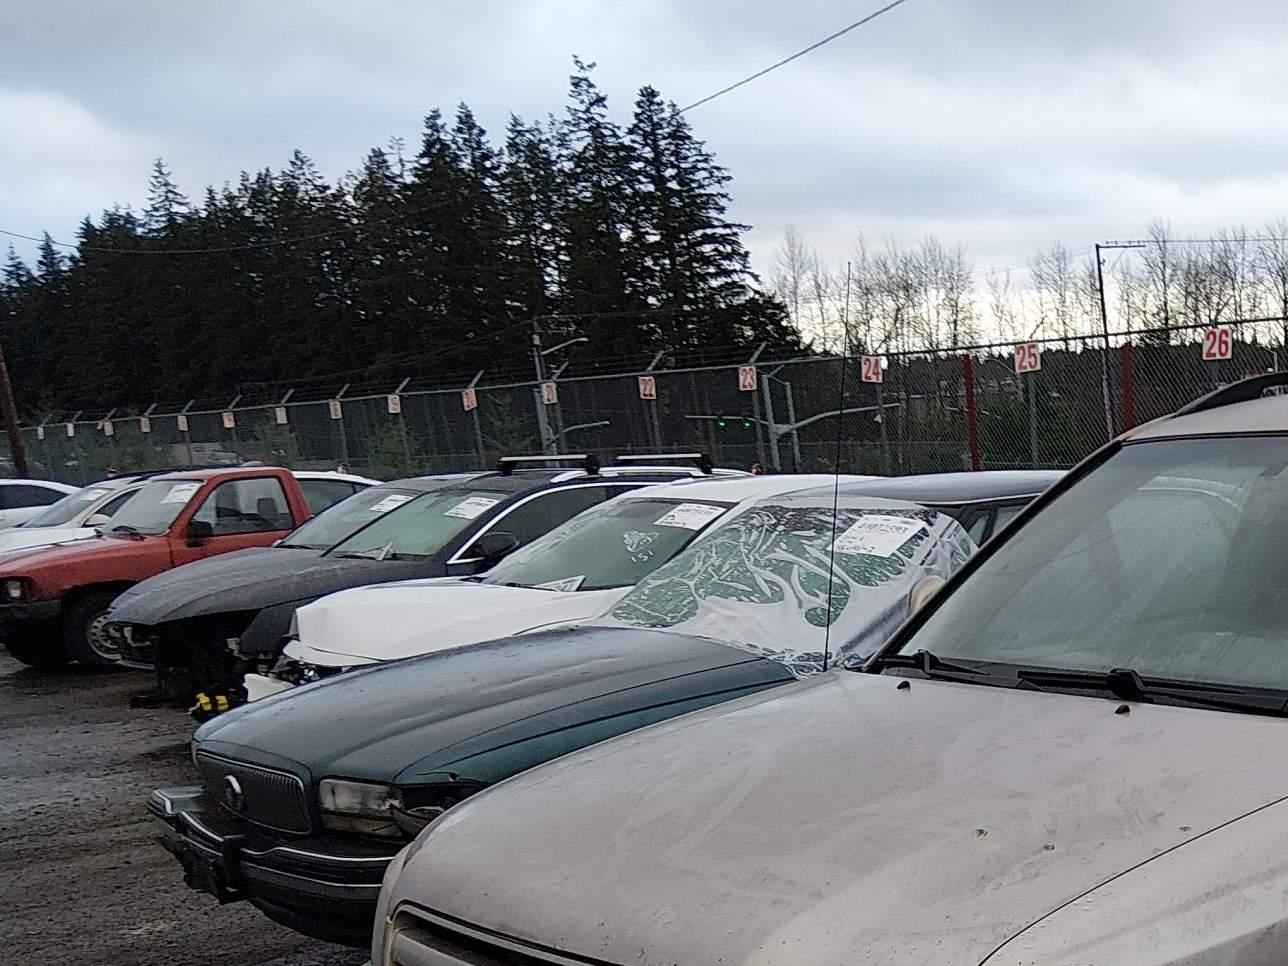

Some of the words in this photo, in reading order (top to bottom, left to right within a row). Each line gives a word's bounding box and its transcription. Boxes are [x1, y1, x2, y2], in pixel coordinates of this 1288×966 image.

[1204, 329, 1229, 358] 26
[863, 357, 881, 381] 24
[1016, 344, 1038, 370] 25
[640, 378, 655, 398] 22
[741, 367, 755, 389] 23
